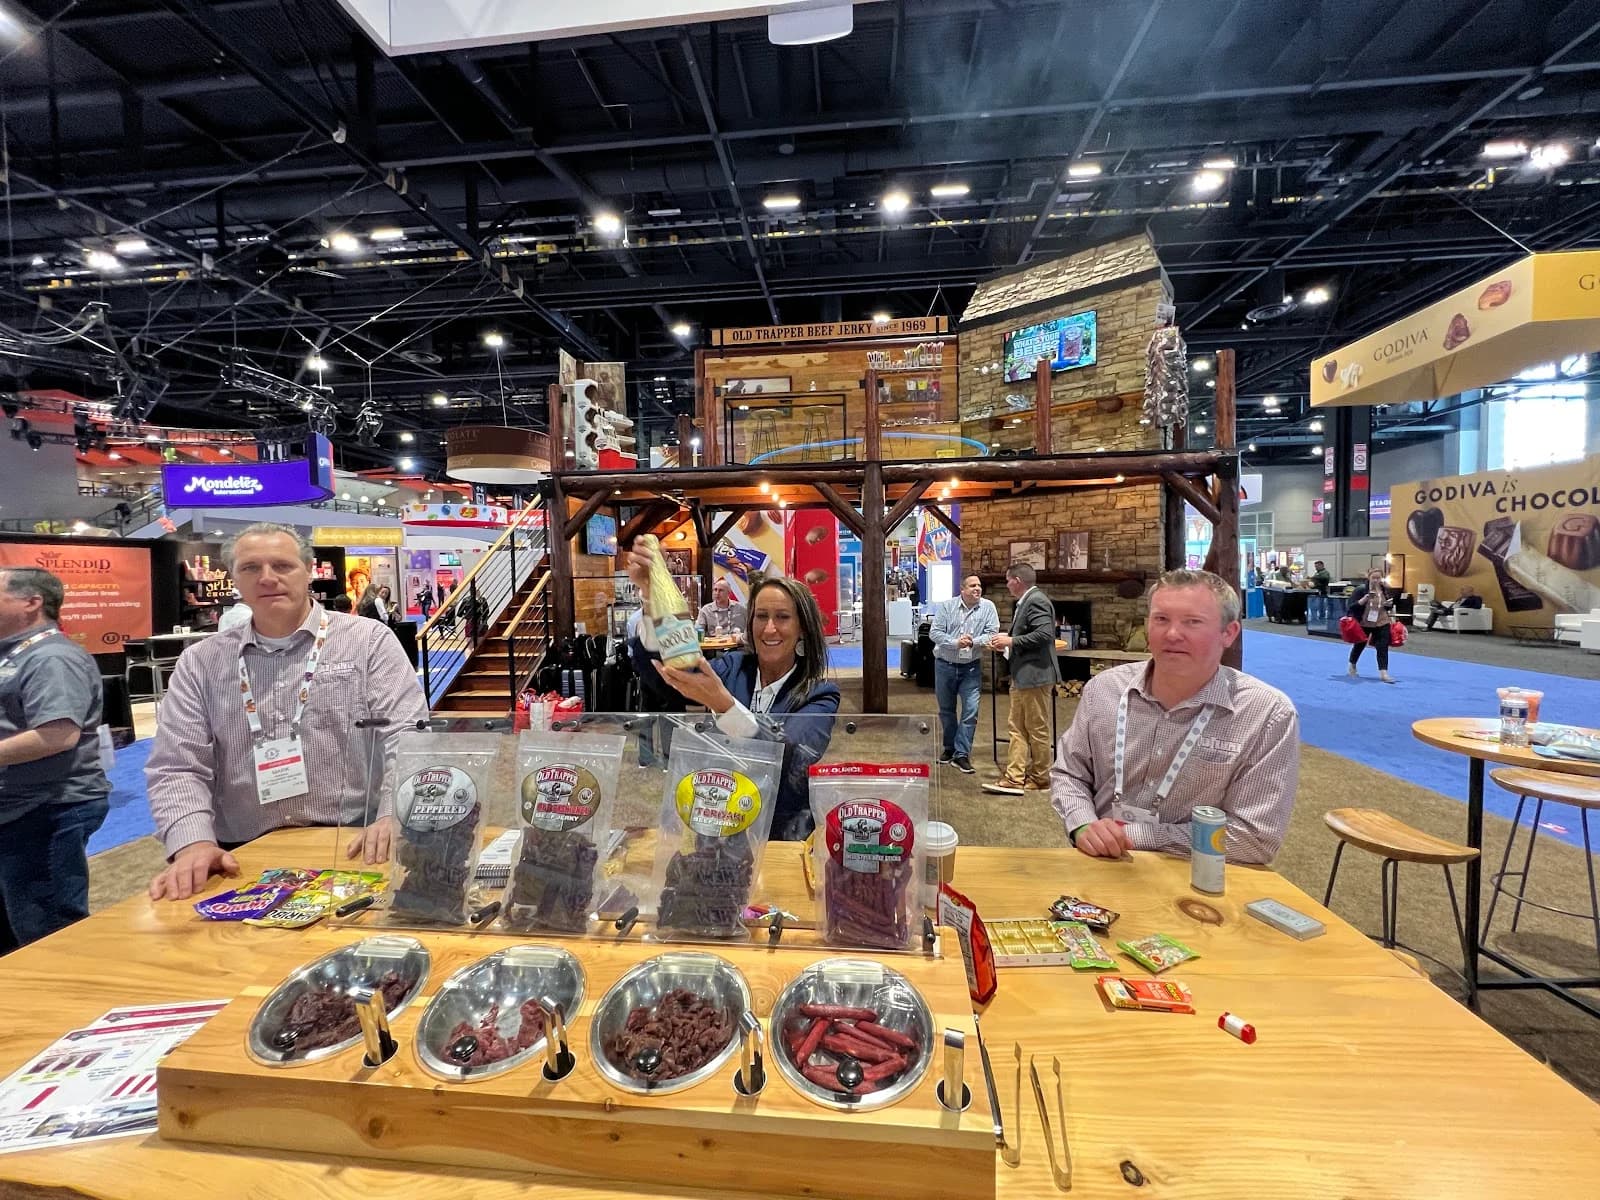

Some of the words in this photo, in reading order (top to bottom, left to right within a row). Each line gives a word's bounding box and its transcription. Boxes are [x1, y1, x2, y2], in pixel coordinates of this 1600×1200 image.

[733, 330, 752, 341] OLD
[755, 327, 804, 340] TRAPPER
[807, 325, 835, 337] BEEF
[837, 322, 872, 335] JERKY
[876, 323, 898, 333] SINCE
[901, 320, 926, 332] 1969
[1041, 331, 1060, 342] YOUR
[1373, 328, 1429, 361] GODIVA
[1415, 480, 1497, 504] GODIVA
[1502, 474, 1518, 494] is
[1495, 486, 1600, 513] CHOCOL
[35, 557, 111, 570] SPLENDID
[537, 771, 549, 782] OLD
[550, 769, 578, 784] TRAPPER
[693, 774, 706, 785] OLD
[706, 773, 737, 793] TRAPPER
[414, 805, 467, 815] PEPPERED
[839, 807, 853, 819] OLD
[853, 805, 887, 821] TRAPPER
